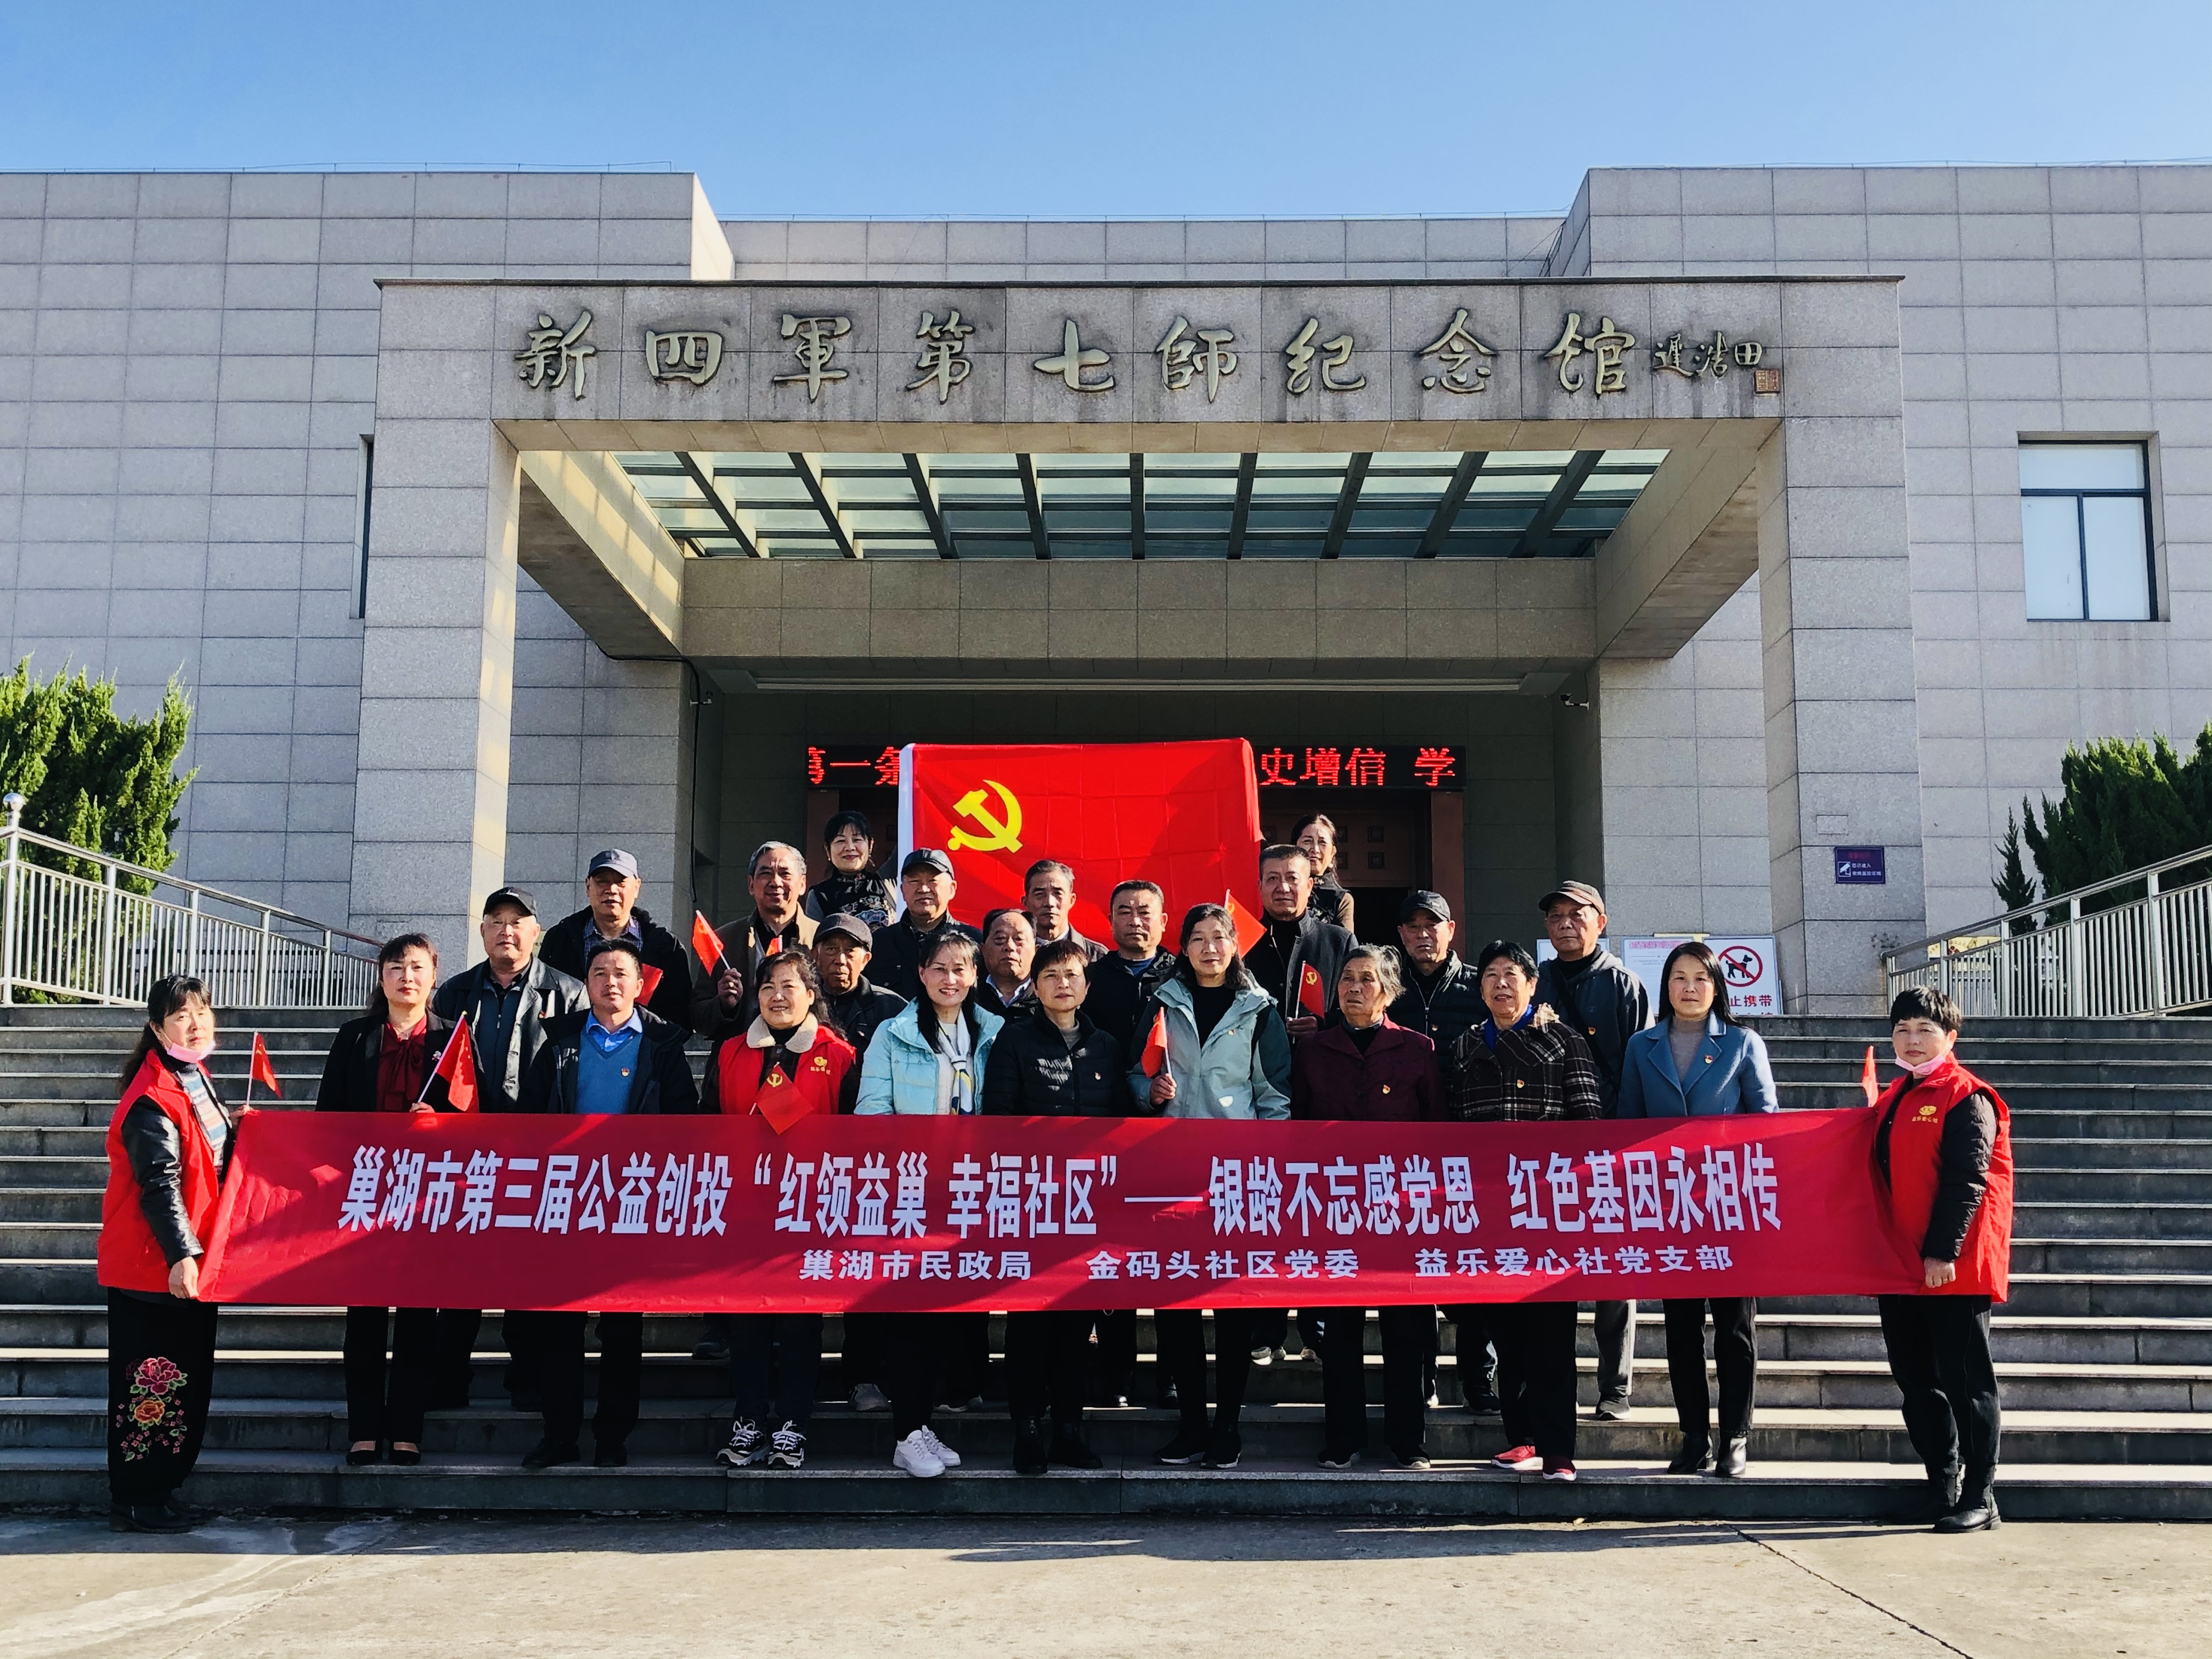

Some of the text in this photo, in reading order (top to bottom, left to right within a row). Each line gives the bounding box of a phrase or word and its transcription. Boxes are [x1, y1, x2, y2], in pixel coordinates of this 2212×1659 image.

[1259, 747, 1387, 786] 史增信
[1414, 747, 1456, 787] 学
[338, 1145, 733, 1237] 巢湖市第三届公益创投
[1507, 1143, 1781, 1233] 红色基因永相传
[799, 1245, 1734, 1280] 巢湖市民政局 金码头社区党委 益乐爱心社党支部
